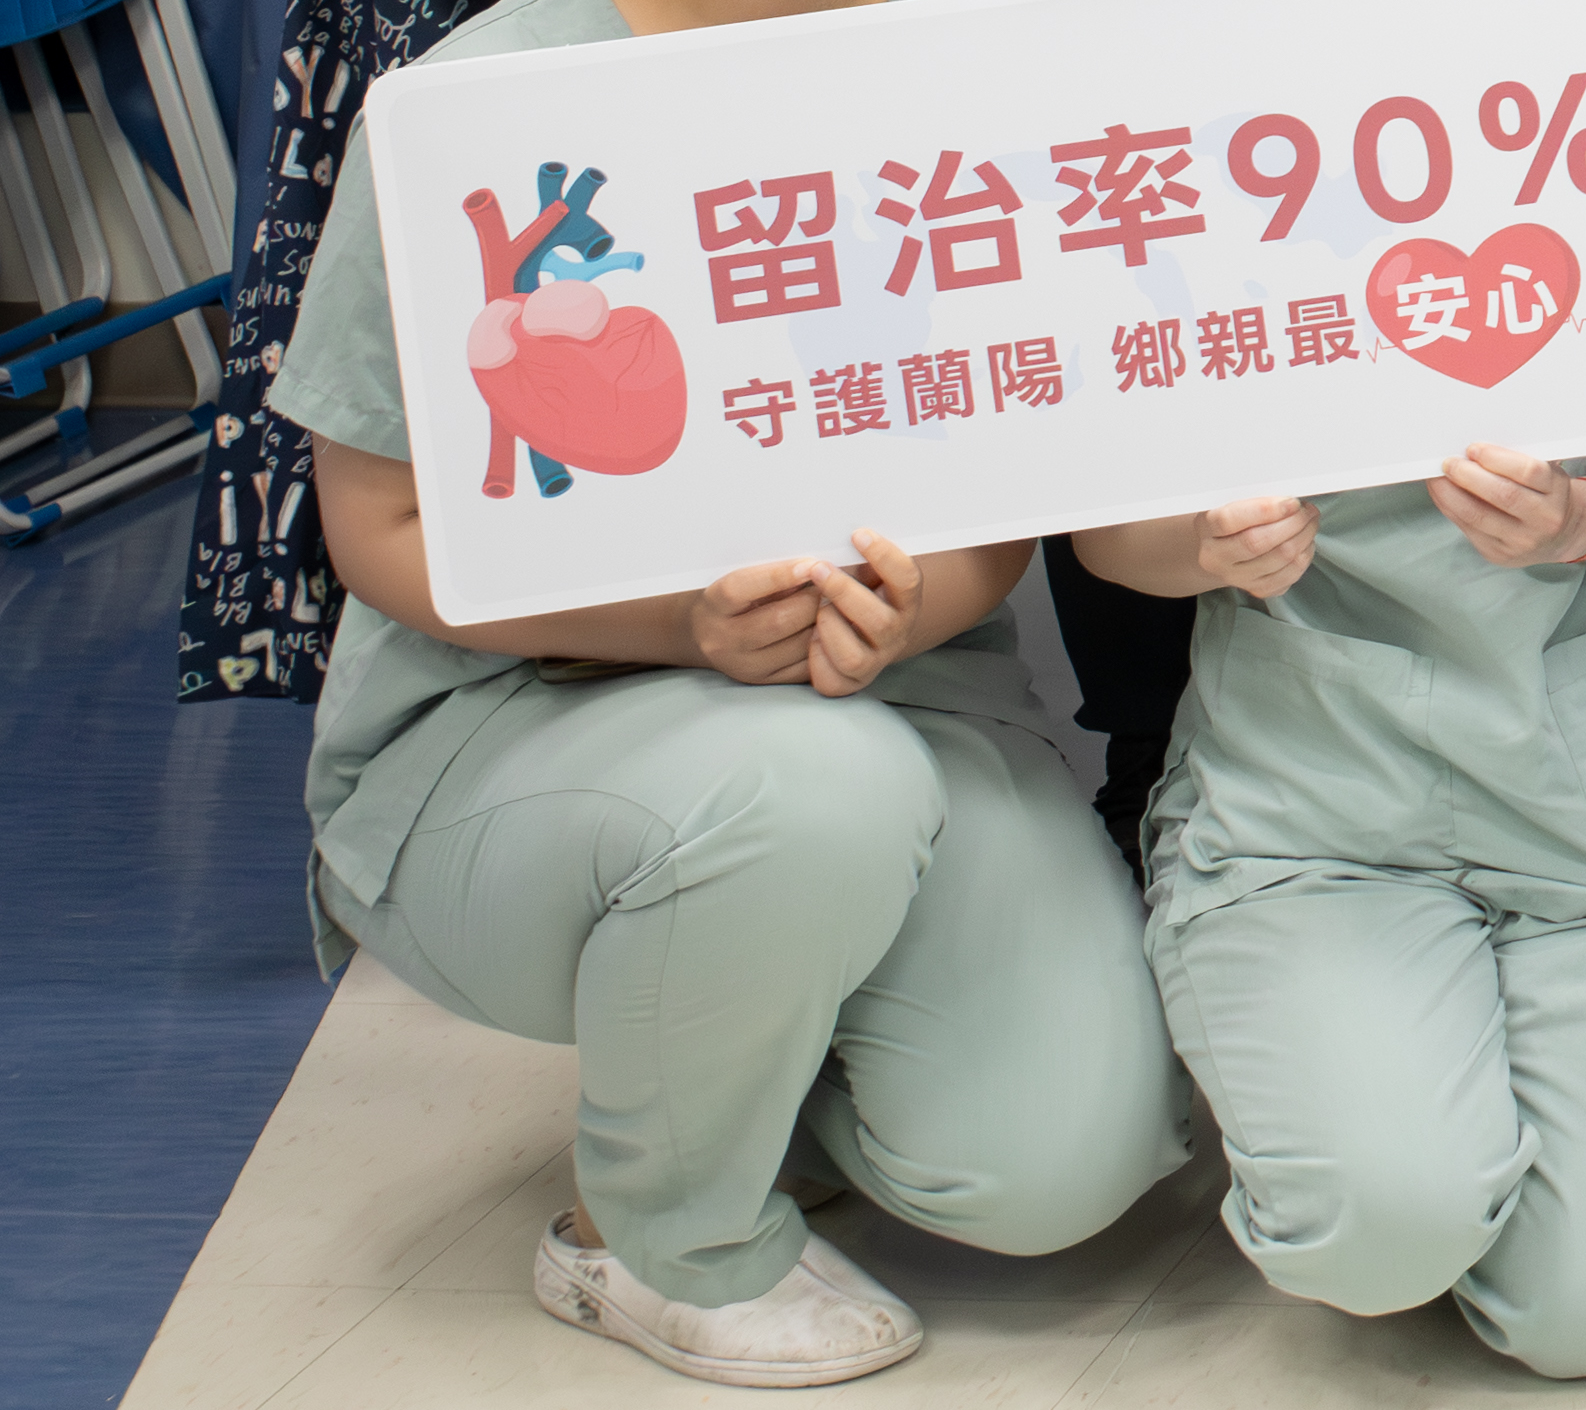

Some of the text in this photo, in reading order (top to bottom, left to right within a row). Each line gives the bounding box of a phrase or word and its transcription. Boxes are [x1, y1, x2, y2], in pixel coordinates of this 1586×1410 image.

[722, 261, 1560, 449] 守護蘭陽 鄉親最 安心
